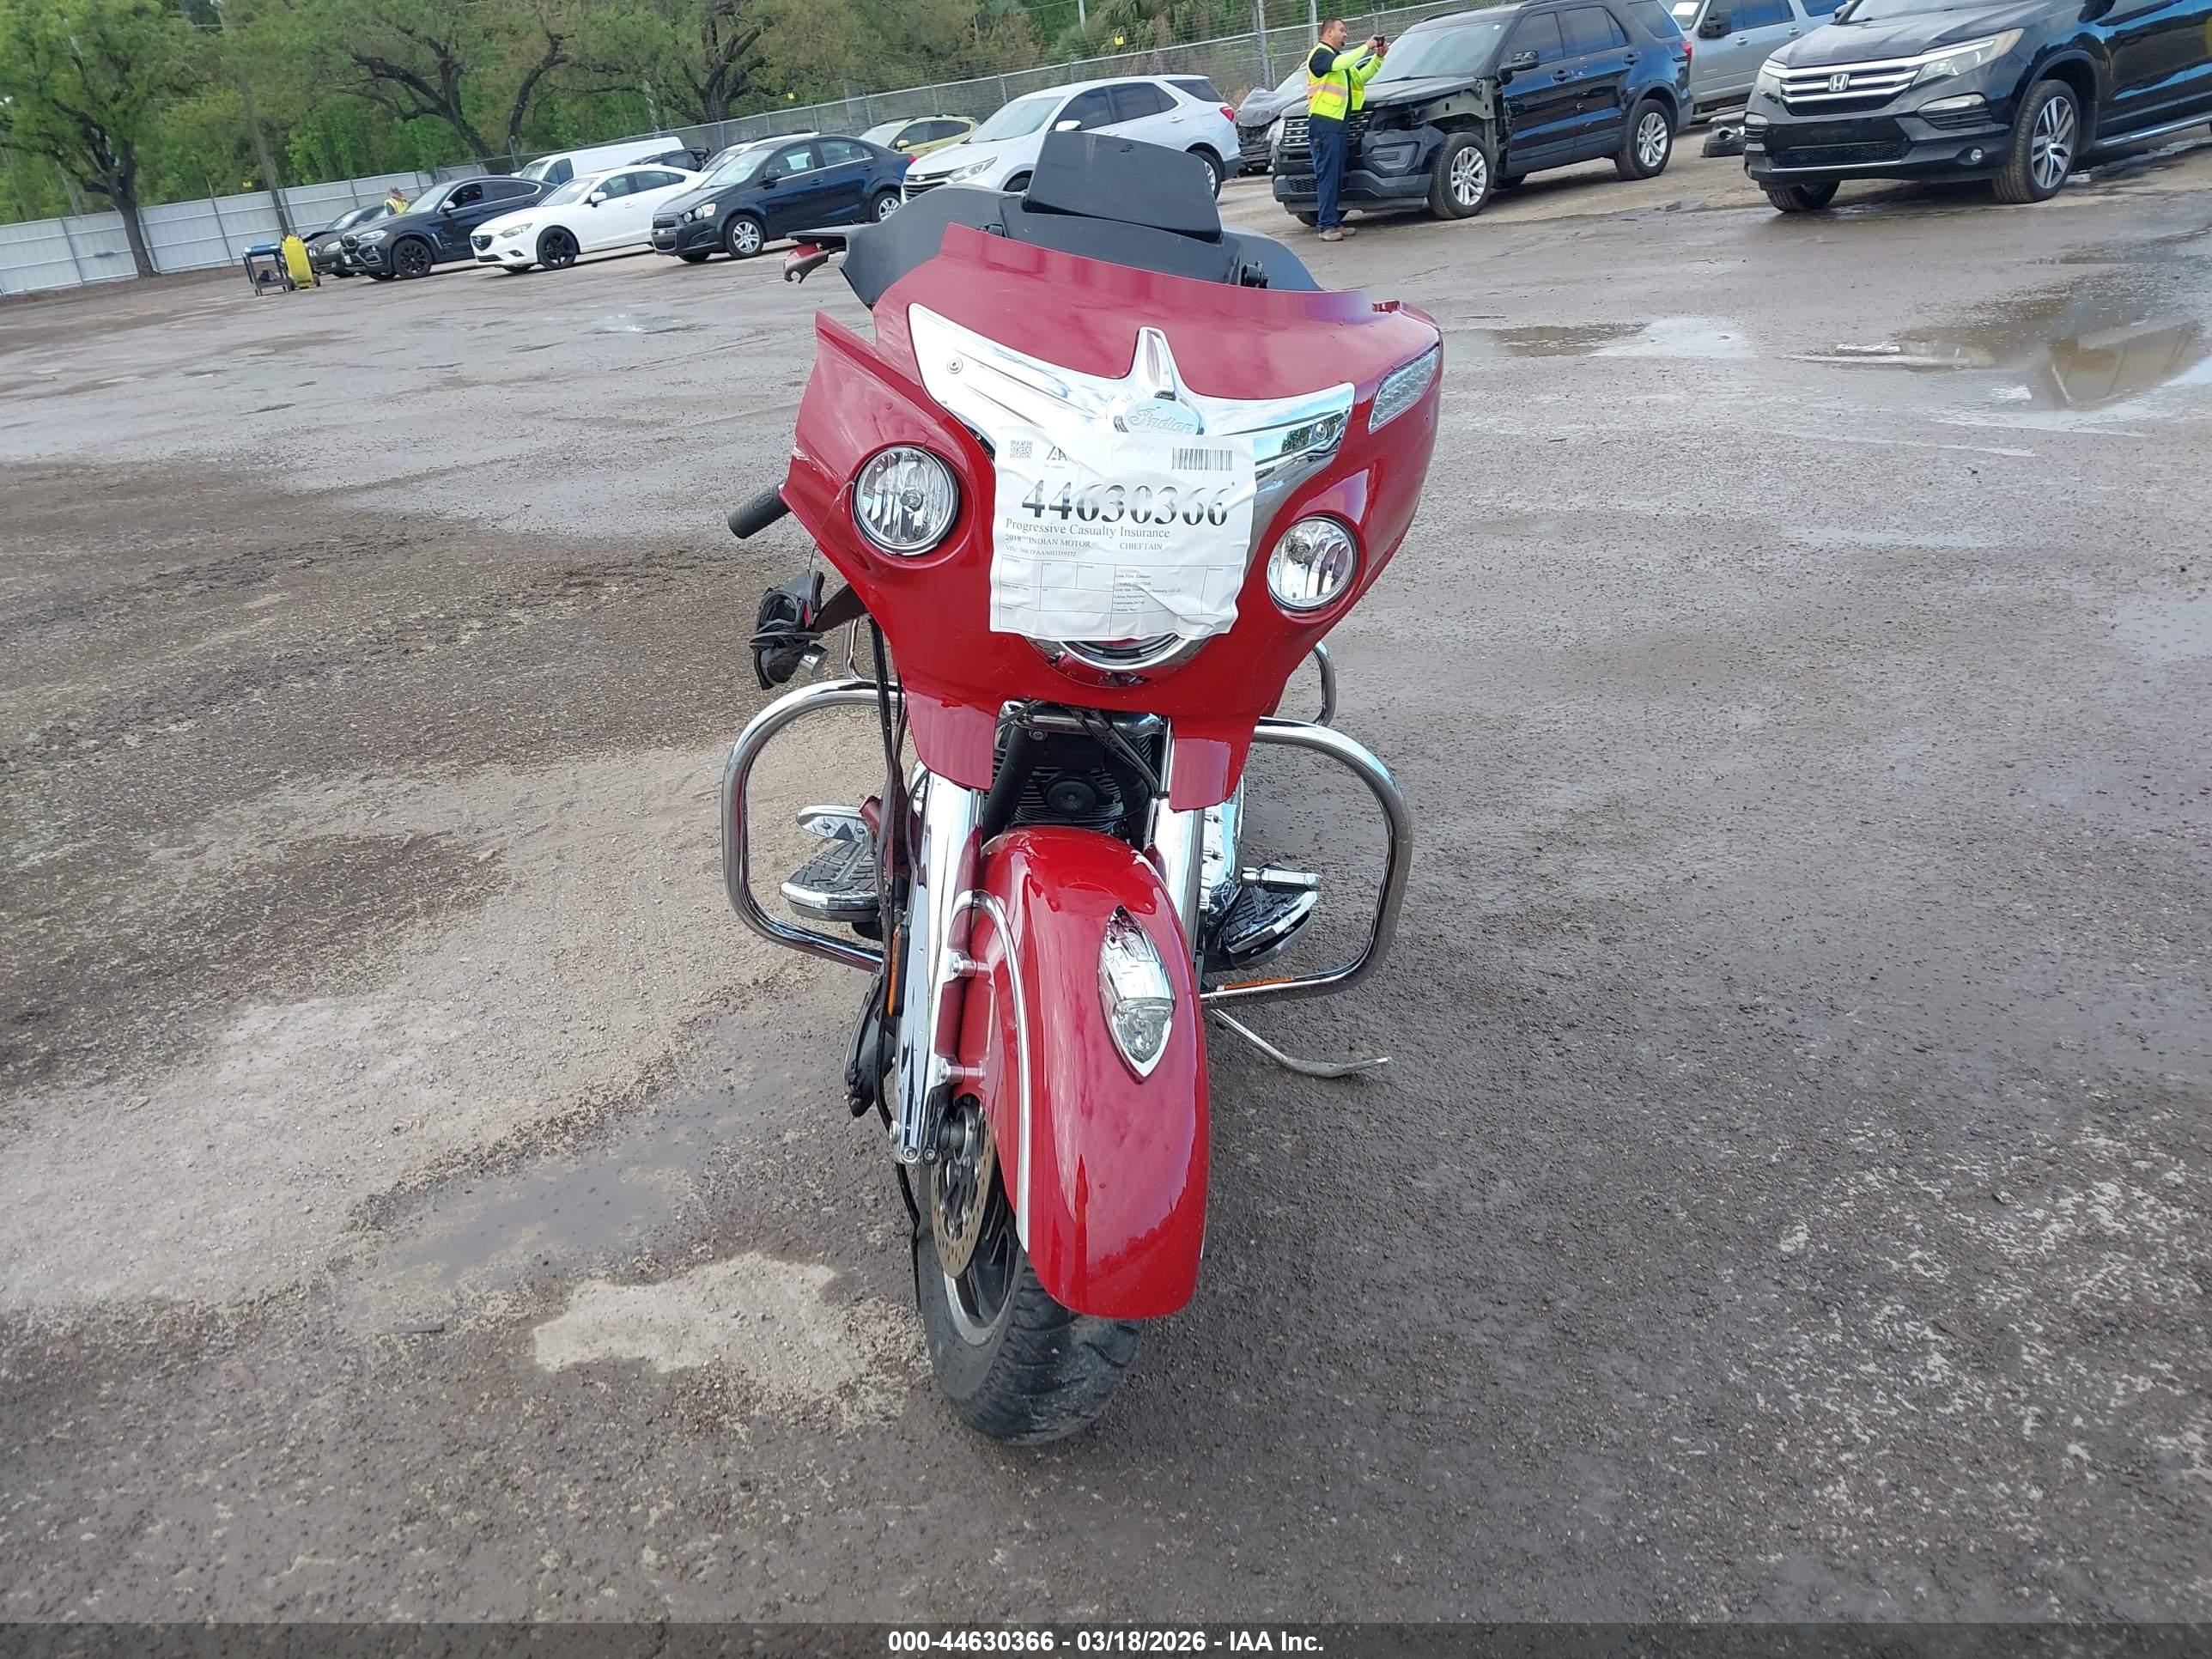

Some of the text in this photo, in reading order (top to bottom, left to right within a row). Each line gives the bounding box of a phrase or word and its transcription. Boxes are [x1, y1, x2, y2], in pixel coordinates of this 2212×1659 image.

[1128, 406, 1194, 434] Indian
[1022, 479, 1229, 526] 44630366
[1006, 518, 1170, 539] Progressive Casualty Insurance
[1029, 537, 1058, 545] INDIAN
[1060, 538, 1091, 548] MOTOR
[1119, 542, 1163, 550] CHIEFTAIN
